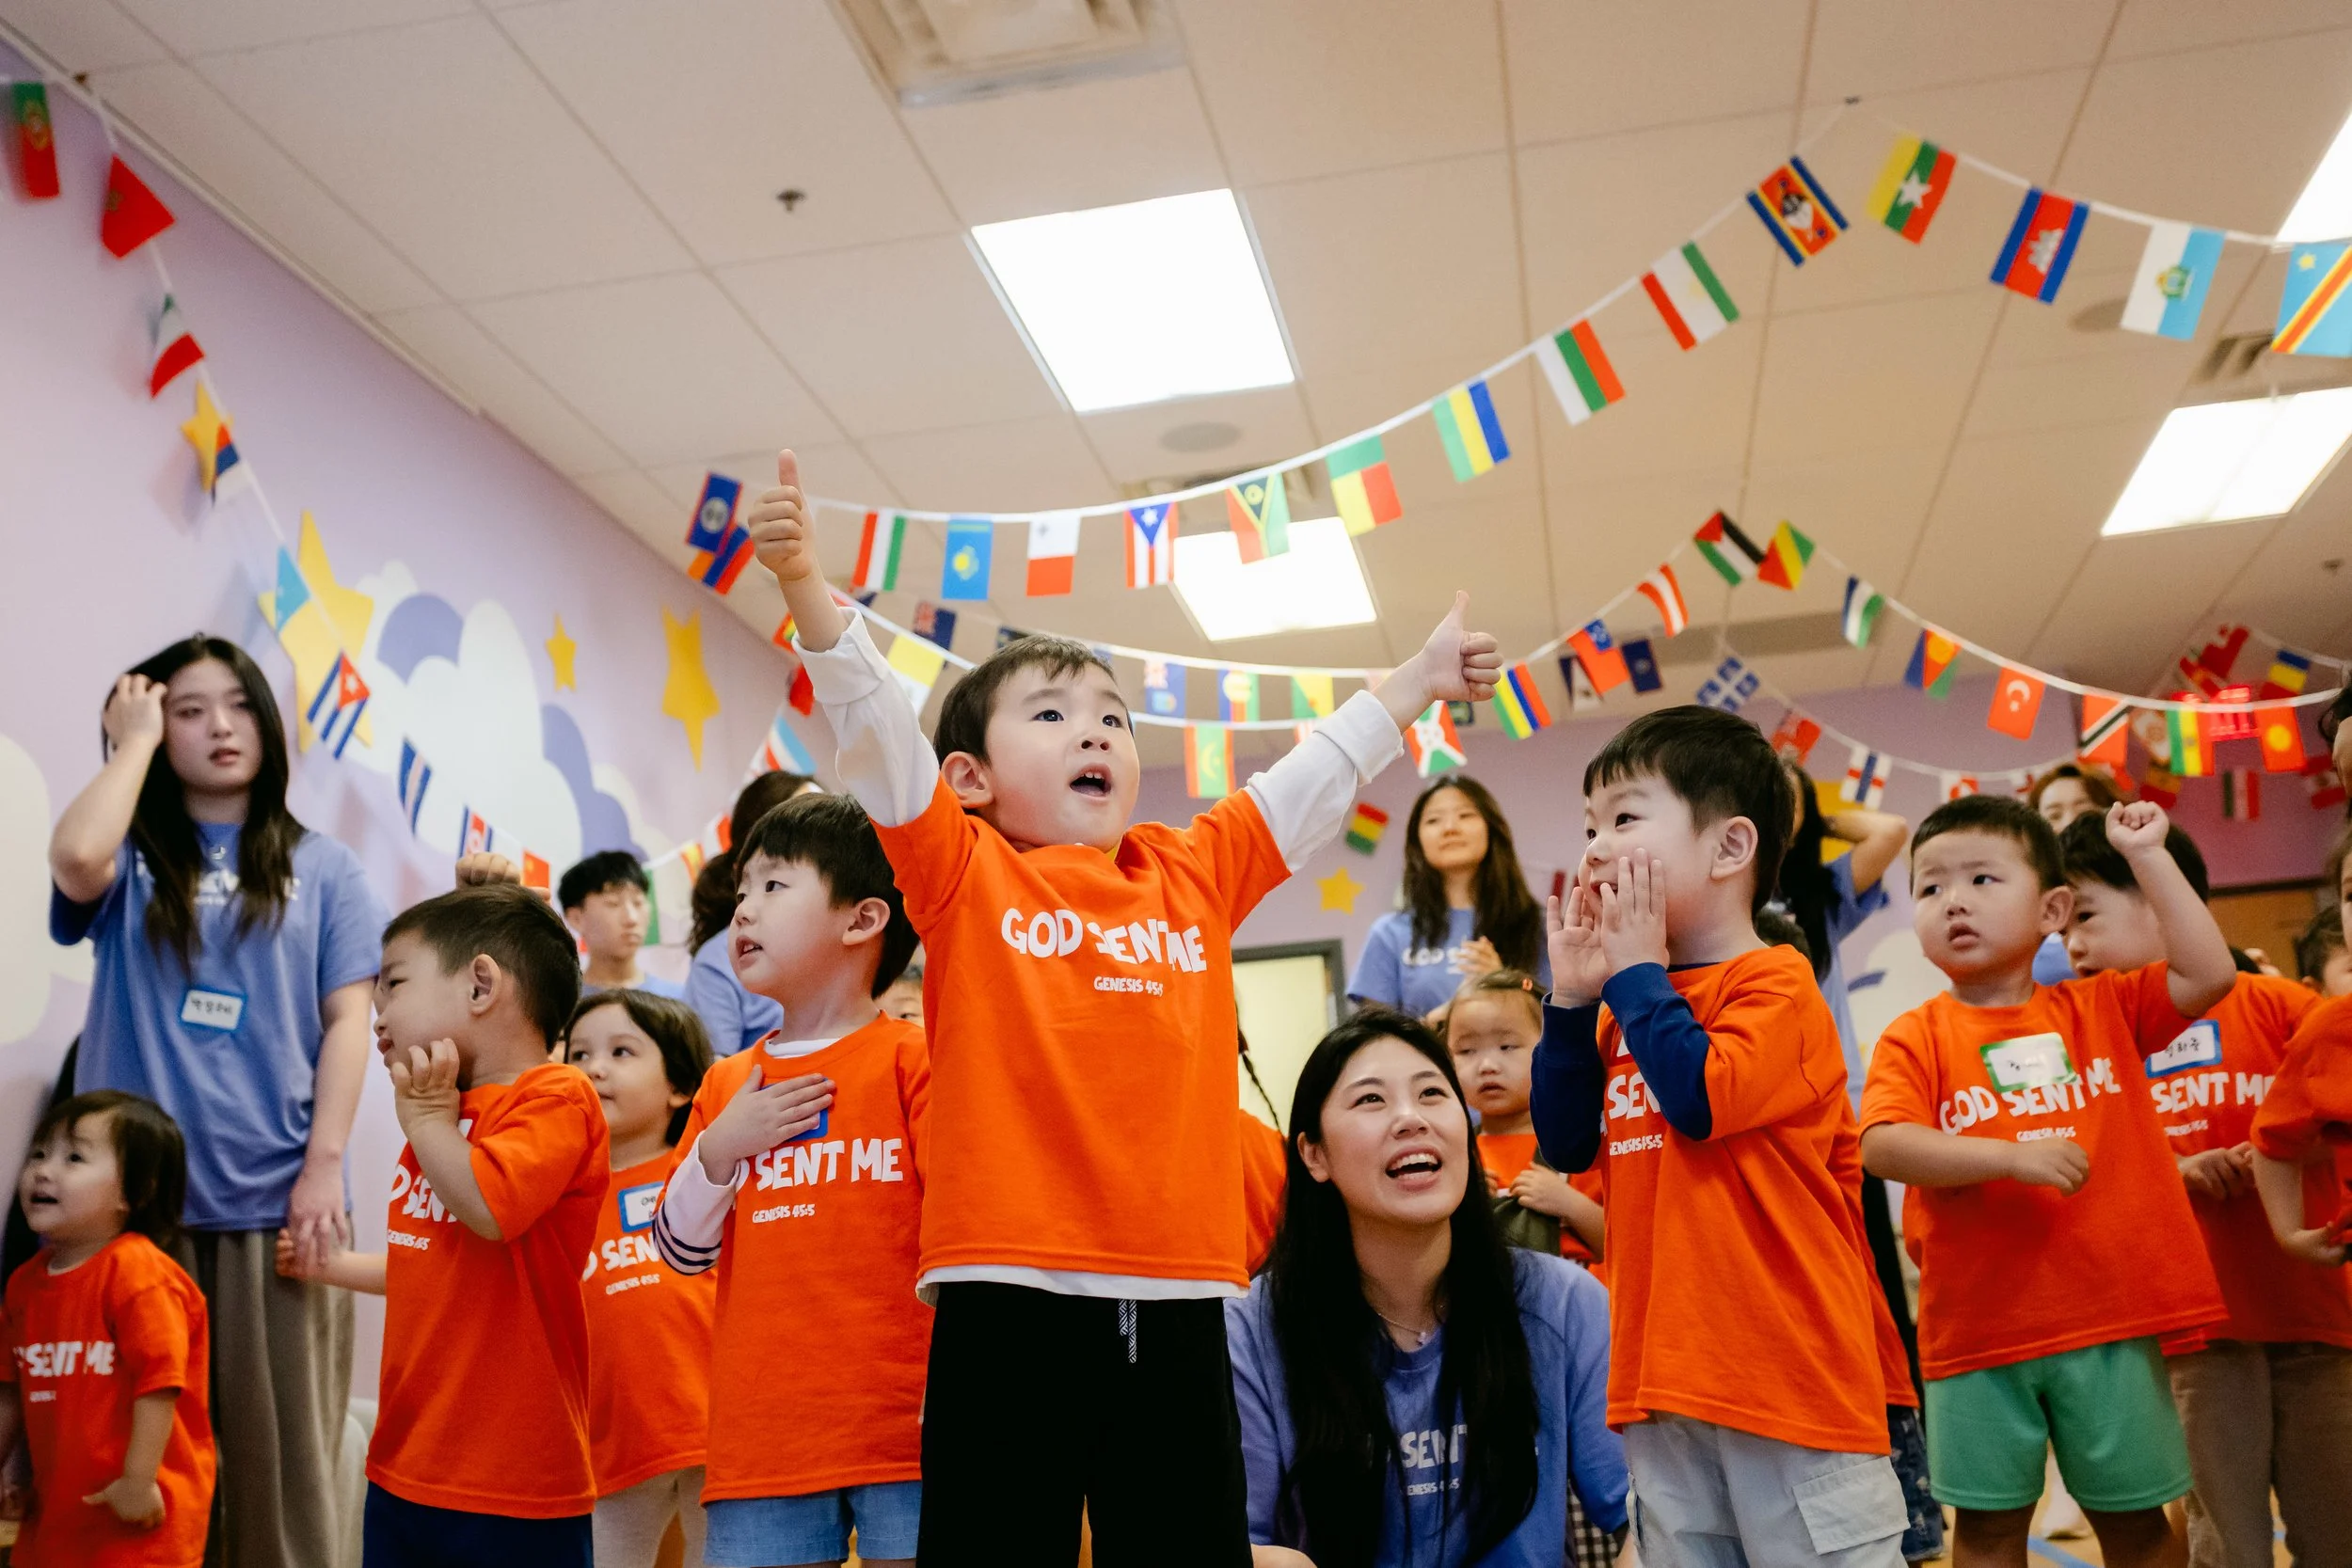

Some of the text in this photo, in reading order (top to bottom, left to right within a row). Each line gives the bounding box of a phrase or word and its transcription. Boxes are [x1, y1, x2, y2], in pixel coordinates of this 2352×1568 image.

[1001, 908, 1083, 958] GOD
[1094, 976, 1144, 993] GENESIS
[1607, 1070, 1661, 1119] SEN
[1940, 1057, 2122, 1136] GOD SENT ME
[2151, 1072, 2230, 1114] SENT
[755, 1141, 844, 1192] SENT
[850, 1138, 903, 1182] ME
[1609, 1137, 1642, 1156] ENESIS
[402, 1175, 458, 1223] SEN
[752, 1203, 816, 1224] GENESIS 45:5
[601, 1233, 660, 1271] SEN
[25, 1341, 83, 1377] SENT
[1407, 1482, 1438, 1496] ENESIS
